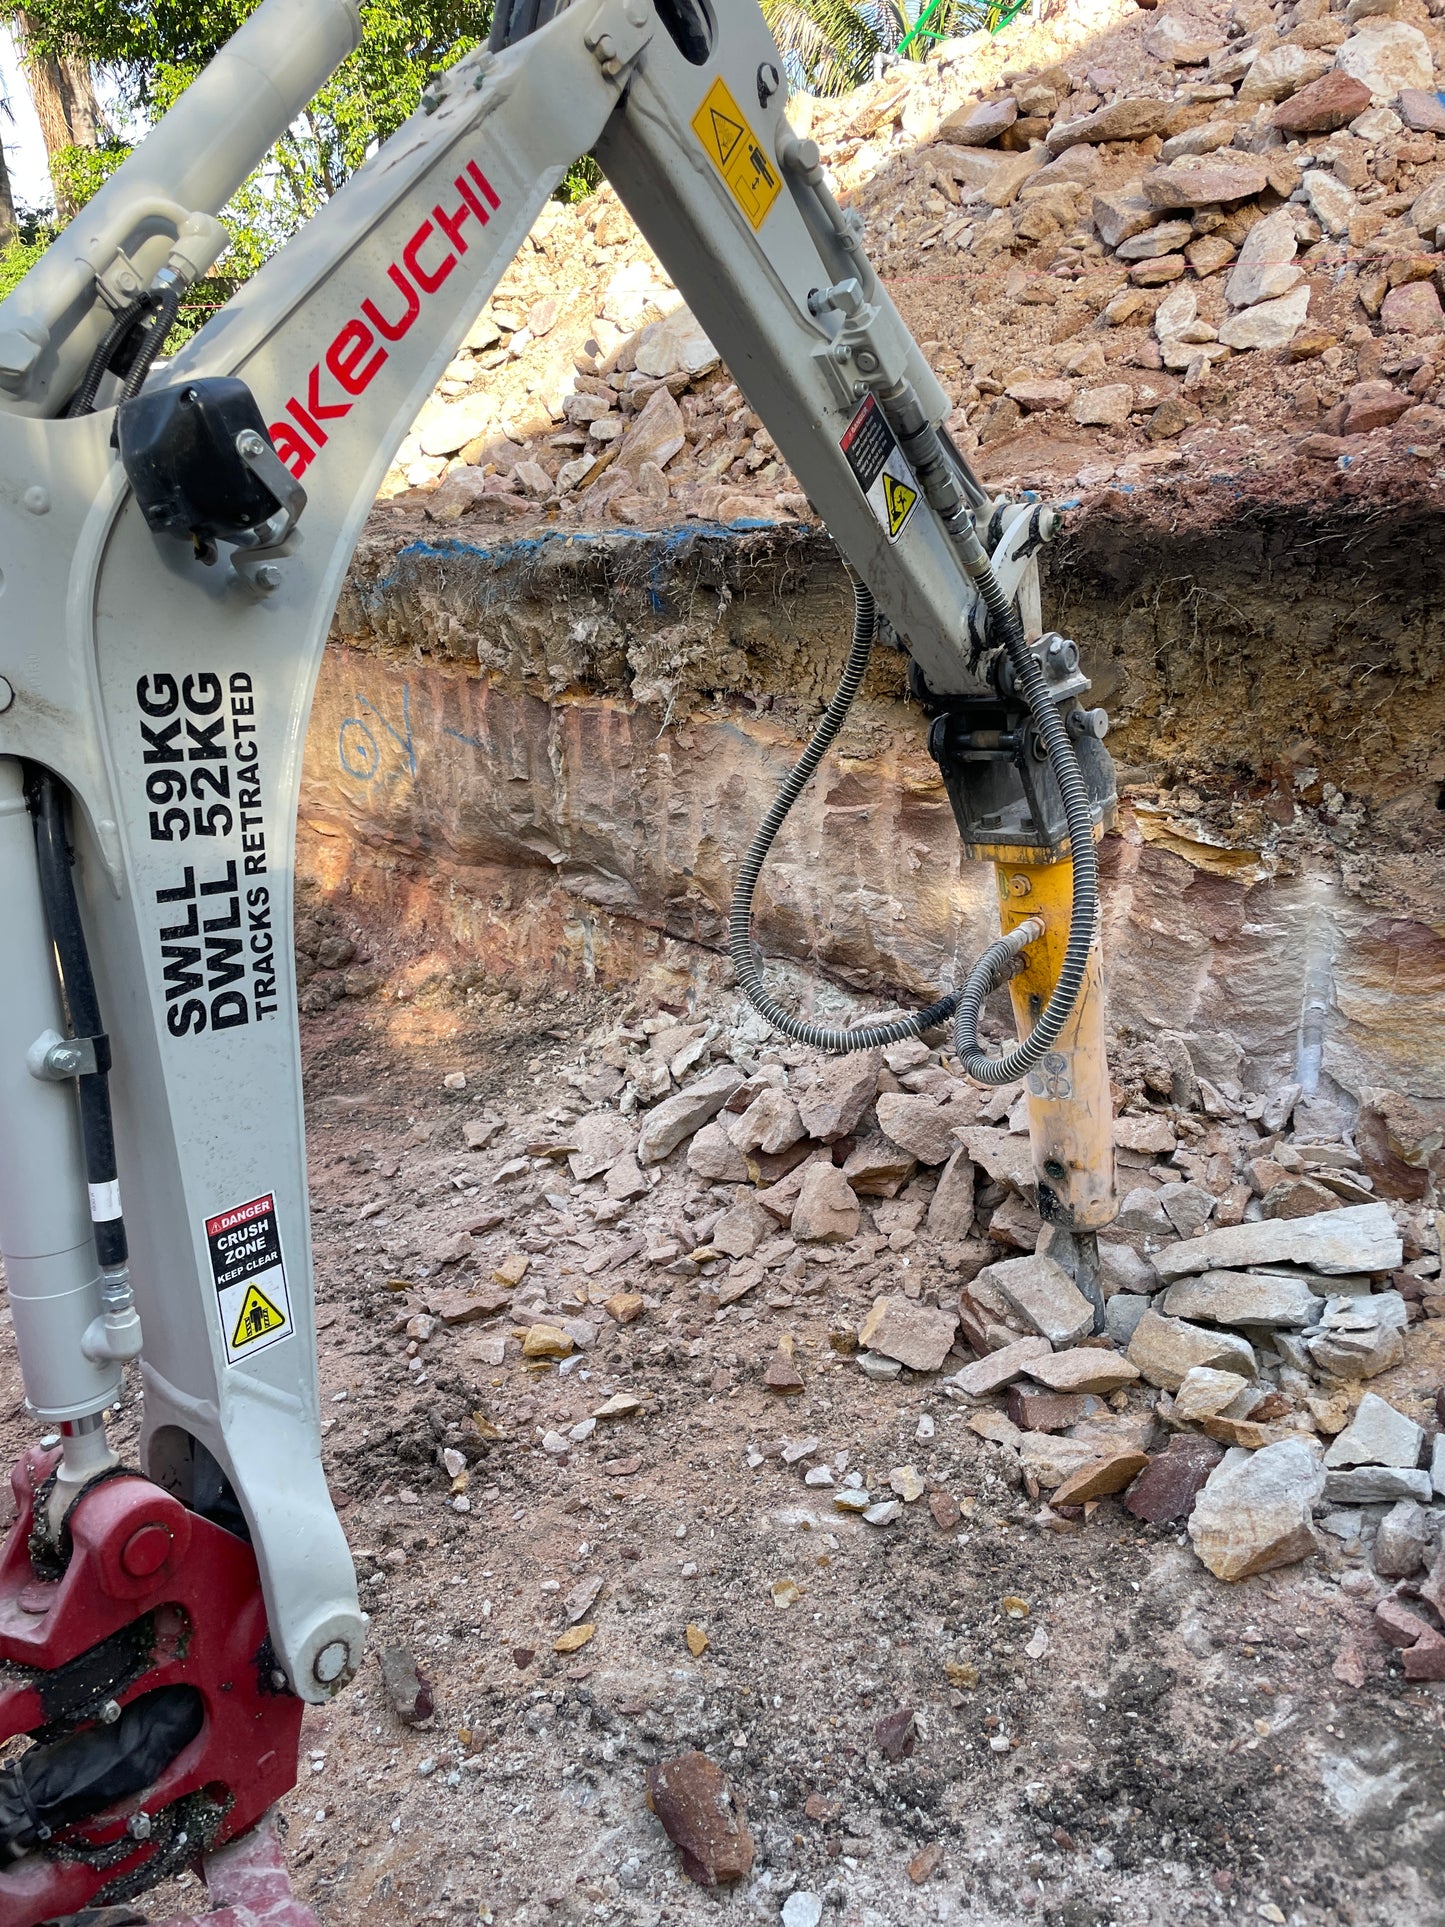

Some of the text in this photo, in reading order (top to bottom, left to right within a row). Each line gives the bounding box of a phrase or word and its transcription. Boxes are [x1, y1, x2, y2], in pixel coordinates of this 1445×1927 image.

[267, 160, 501, 480] aKeUCHI
[137, 673, 207, 1037] SWLL 59KG
[182, 673, 248, 1031] DWLL 52KG
[229, 672, 278, 1021] TRACKS RETRACTED
[217, 1219, 269, 1250] CRUSH
[217, 1251, 278, 1285] KEEP CLEAR
[221, 1201, 270, 1228] DANGER
[224, 1236, 266, 1265] ZONE
